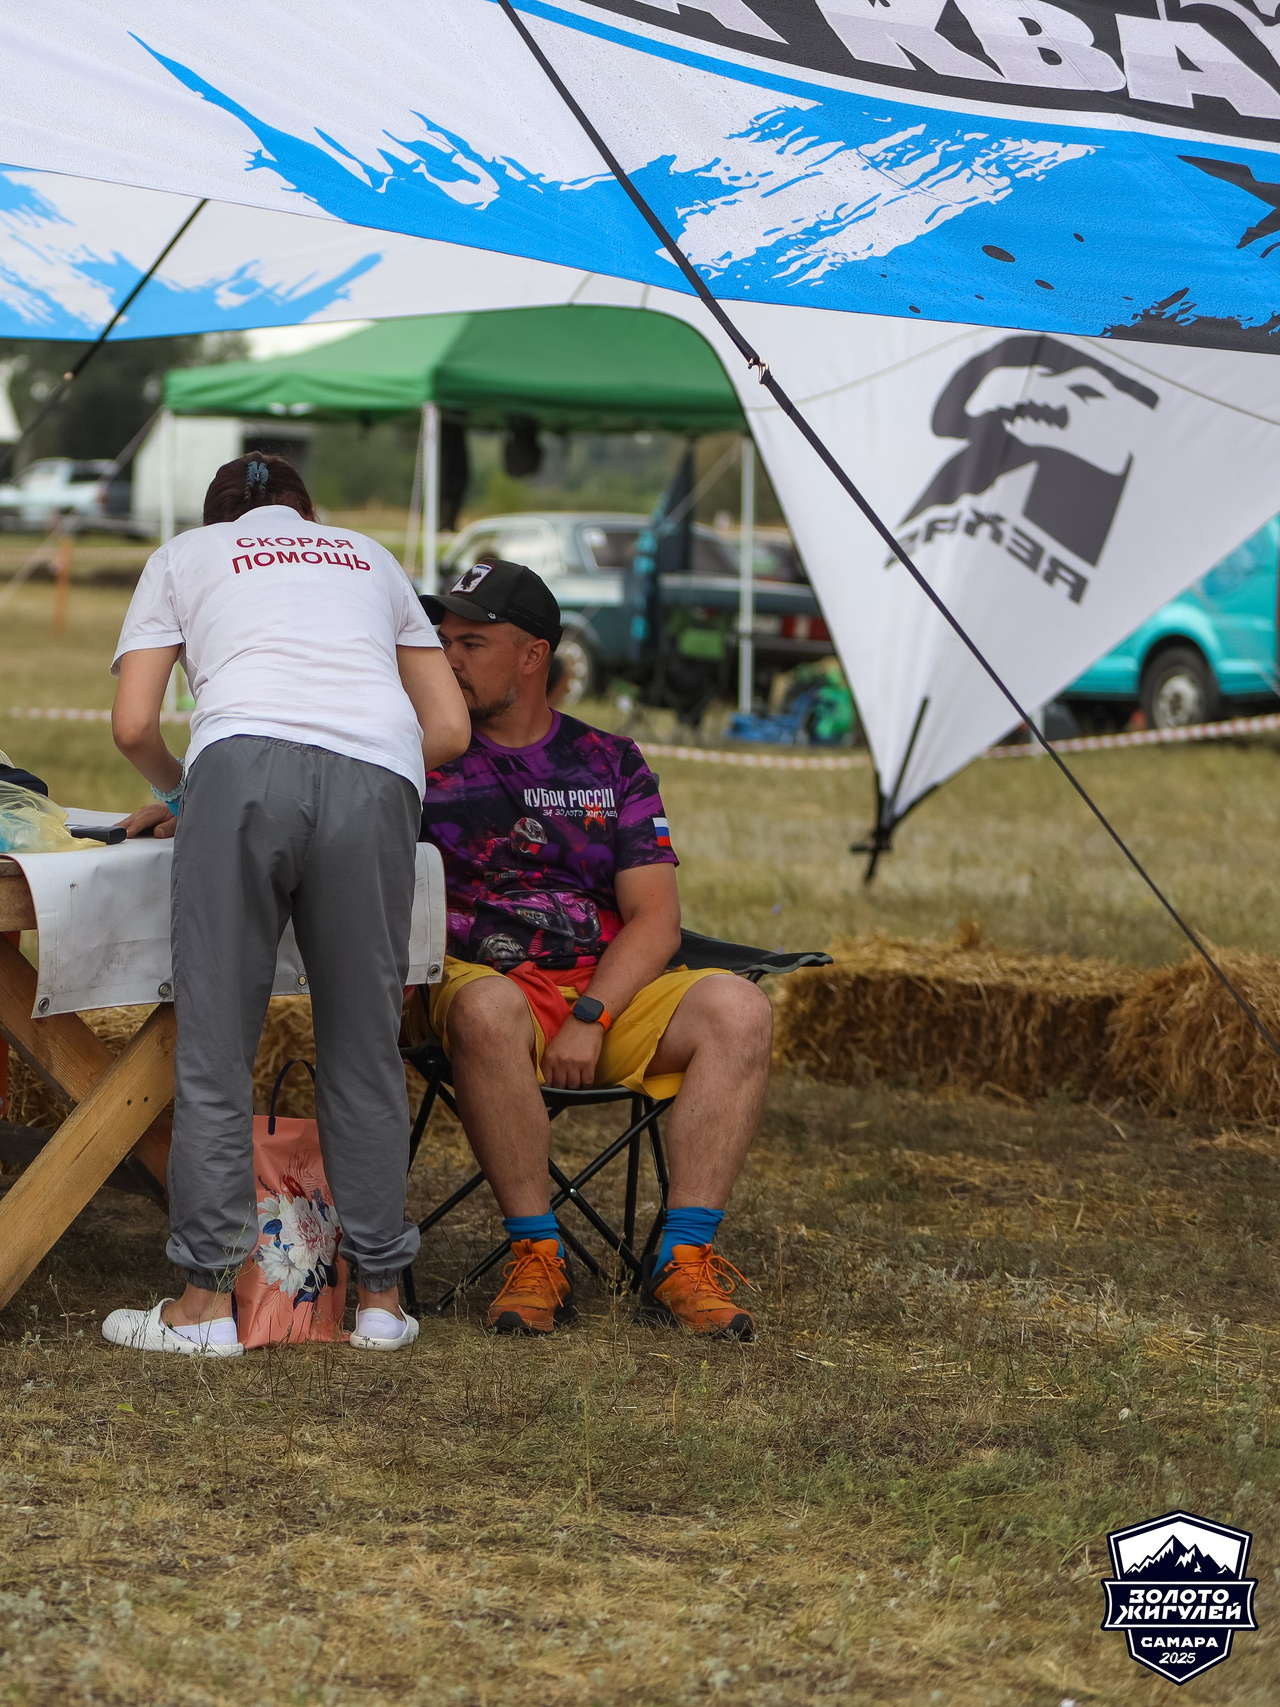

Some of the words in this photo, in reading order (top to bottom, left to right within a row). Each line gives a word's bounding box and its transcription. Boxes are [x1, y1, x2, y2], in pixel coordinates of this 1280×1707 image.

[236, 537, 354, 549] СКОРАЯ
[232, 551, 371, 574] ПОМОЩЬ
[524, 788, 566, 808] КУБОК
